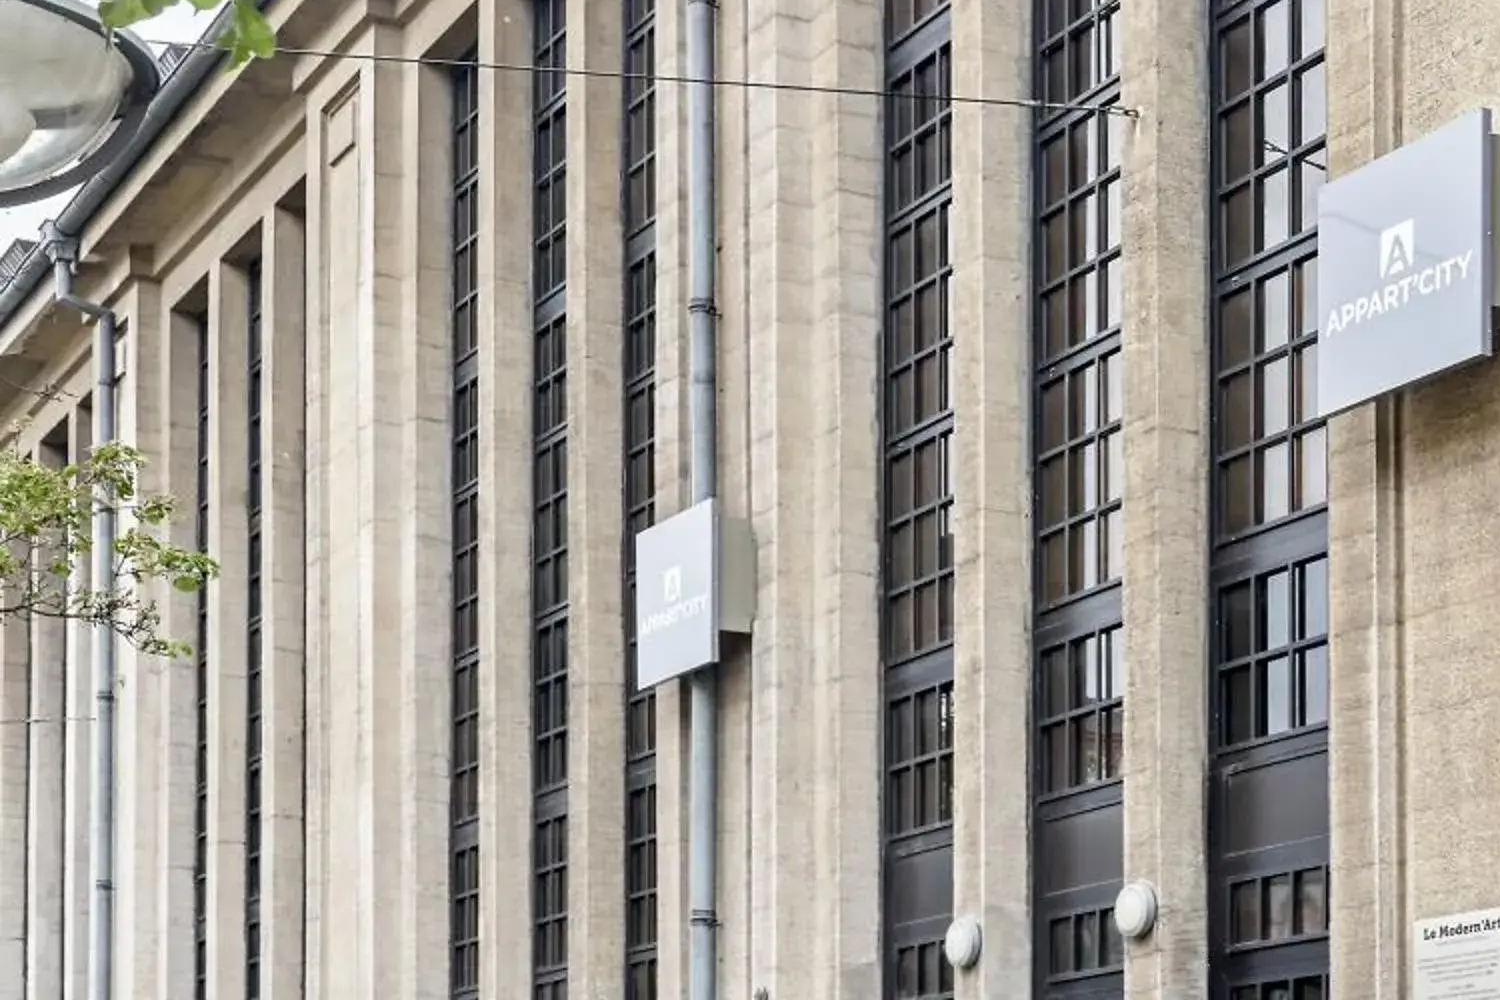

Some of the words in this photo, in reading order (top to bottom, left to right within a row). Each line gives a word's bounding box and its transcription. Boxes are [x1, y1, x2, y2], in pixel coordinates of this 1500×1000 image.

[1381, 219, 1414, 278] A
[1326, 250, 1473, 338] APPART'CITY
[1423, 928, 1437, 941] Le
